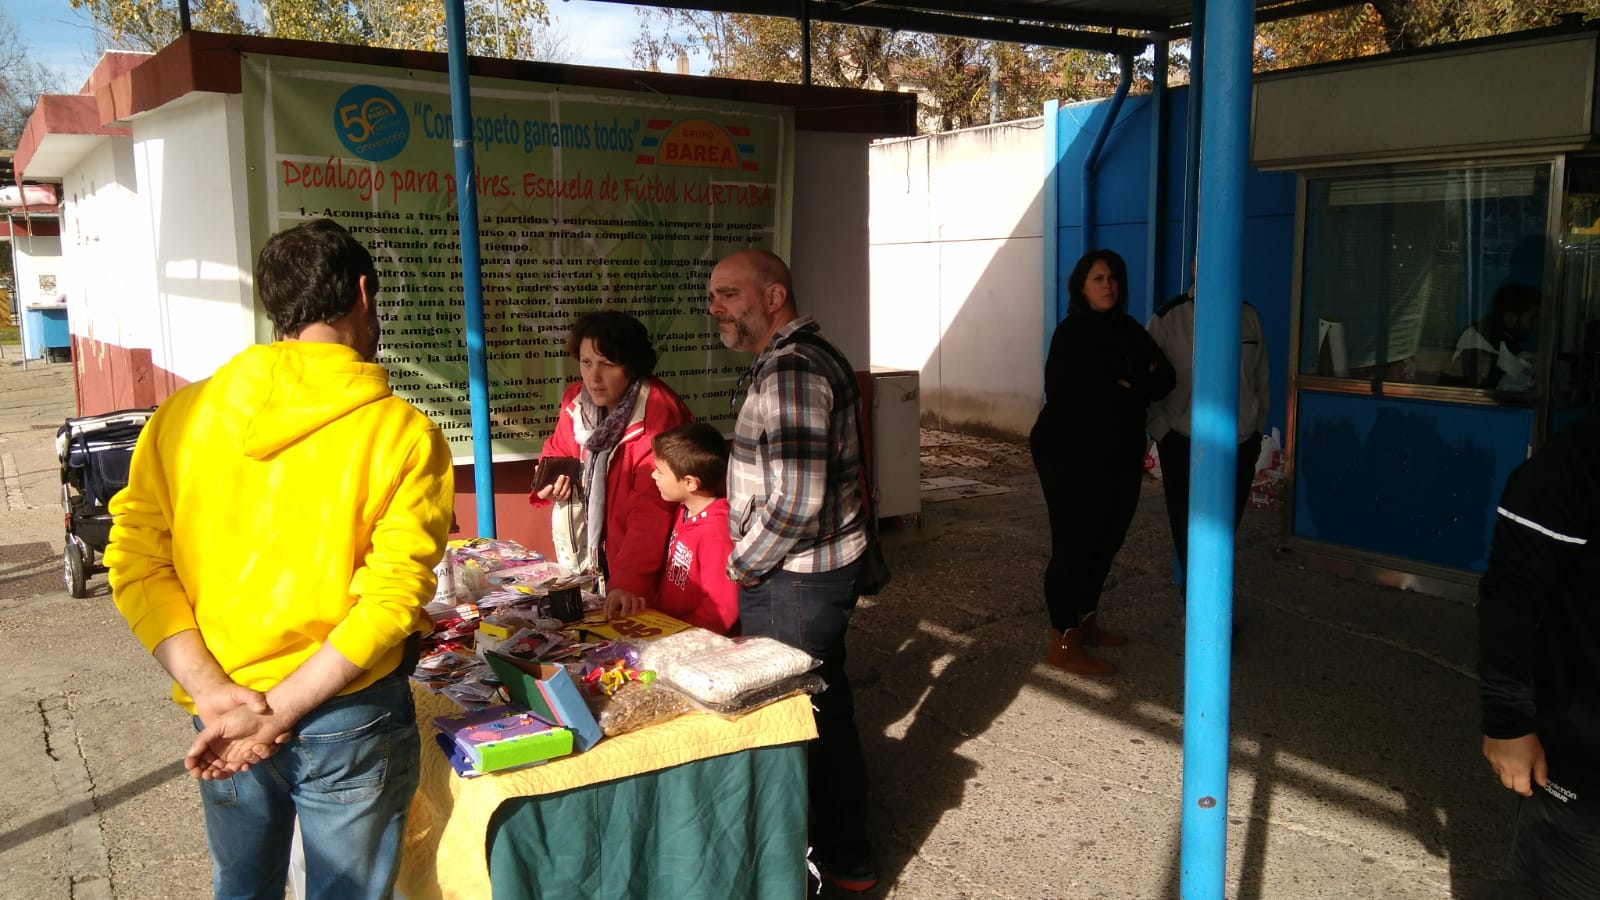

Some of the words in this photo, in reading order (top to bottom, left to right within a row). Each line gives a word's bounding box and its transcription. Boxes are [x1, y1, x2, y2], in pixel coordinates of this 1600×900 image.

[339, 97, 397, 143] 50
[523, 119, 590, 154] ganamos
[682, 128, 714, 139] GRUPO
[665, 142, 733, 164] BAREA
[282, 155, 385, 201] Decálogo
[390, 168, 438, 205] para
[522, 171, 594, 200] Escuela
[600, 170, 619, 201] de
[623, 172, 678, 202] Fútbol
[684, 180, 772, 209] KURTUBA
[323, 207, 401, 220] Acompaña
[405, 212, 415, 220] a
[419, 212, 441, 221] tus
[483, 215, 492, 223] a
[496, 216, 549, 225] partidos
[553, 217, 560, 226] y
[563, 218, 654, 228] entrenamientos
[658, 219, 701, 229] siempre
[704, 223, 724, 231] que
[429, 228, 448, 236] un
[509, 230, 517, 238] o
[521, 230, 545, 238] una
[549, 229, 592, 239] mirada
[595, 230, 648, 241] cómplice
[650, 231, 690, 242] pueden
[693, 234, 711, 242] ser
[713, 234, 743, 244] mejor
[367, 239, 428, 250] gritando
[398, 255, 423, 264] con
[428, 255, 442, 264] tu
[480, 258, 511, 266] para
[515, 258, 538, 267] que
[542, 258, 563, 266] sea
[567, 258, 582, 266] un
[586, 258, 640, 267] referente
[643, 258, 657, 266] en
[660, 258, 690, 268] juego
[421, 270, 446, 279] son
[516, 271, 537, 280] que
[543, 271, 593, 279] aciertan
[596, 272, 603, 281] y
[516, 284, 559, 294] padres
[563, 283, 598, 293] ayuda
[613, 284, 658, 292] generar
[678, 282, 706, 291] clima
[418, 299, 445, 307] una
[555, 295, 602, 305] también
[631, 295, 674, 304] árbitros
[678, 296, 683, 304] y
[416, 313, 431, 321] tu
[435, 312, 461, 323] hijo
[494, 311, 506, 320] el
[510, 310, 569, 320] resultado
[400, 327, 451, 336] amigos
[455, 328, 463, 336] y
[502, 324, 514, 333] lo
[518, 324, 533, 332] ha
[657, 331, 695, 341] trabajo
[698, 332, 711, 340] en
[377, 339, 453, 352] presiones!
[552, 337, 567, 345] es
[658, 344, 668, 353] Si
[672, 344, 698, 352] tiene
[416, 355, 424, 364] y
[427, 353, 441, 363] la
[525, 350, 540, 359] de
[504, 377, 524, 387] sin
[526, 376, 562, 386] hacer
[656, 368, 676, 378] otra
[679, 366, 718, 376] manera
[721, 365, 732, 374] de
[429, 394, 453, 403] sus
[693, 393, 699, 401] y
[540, 403, 554, 411] en
[503, 417, 519, 426] de
[522, 415, 541, 425] las
